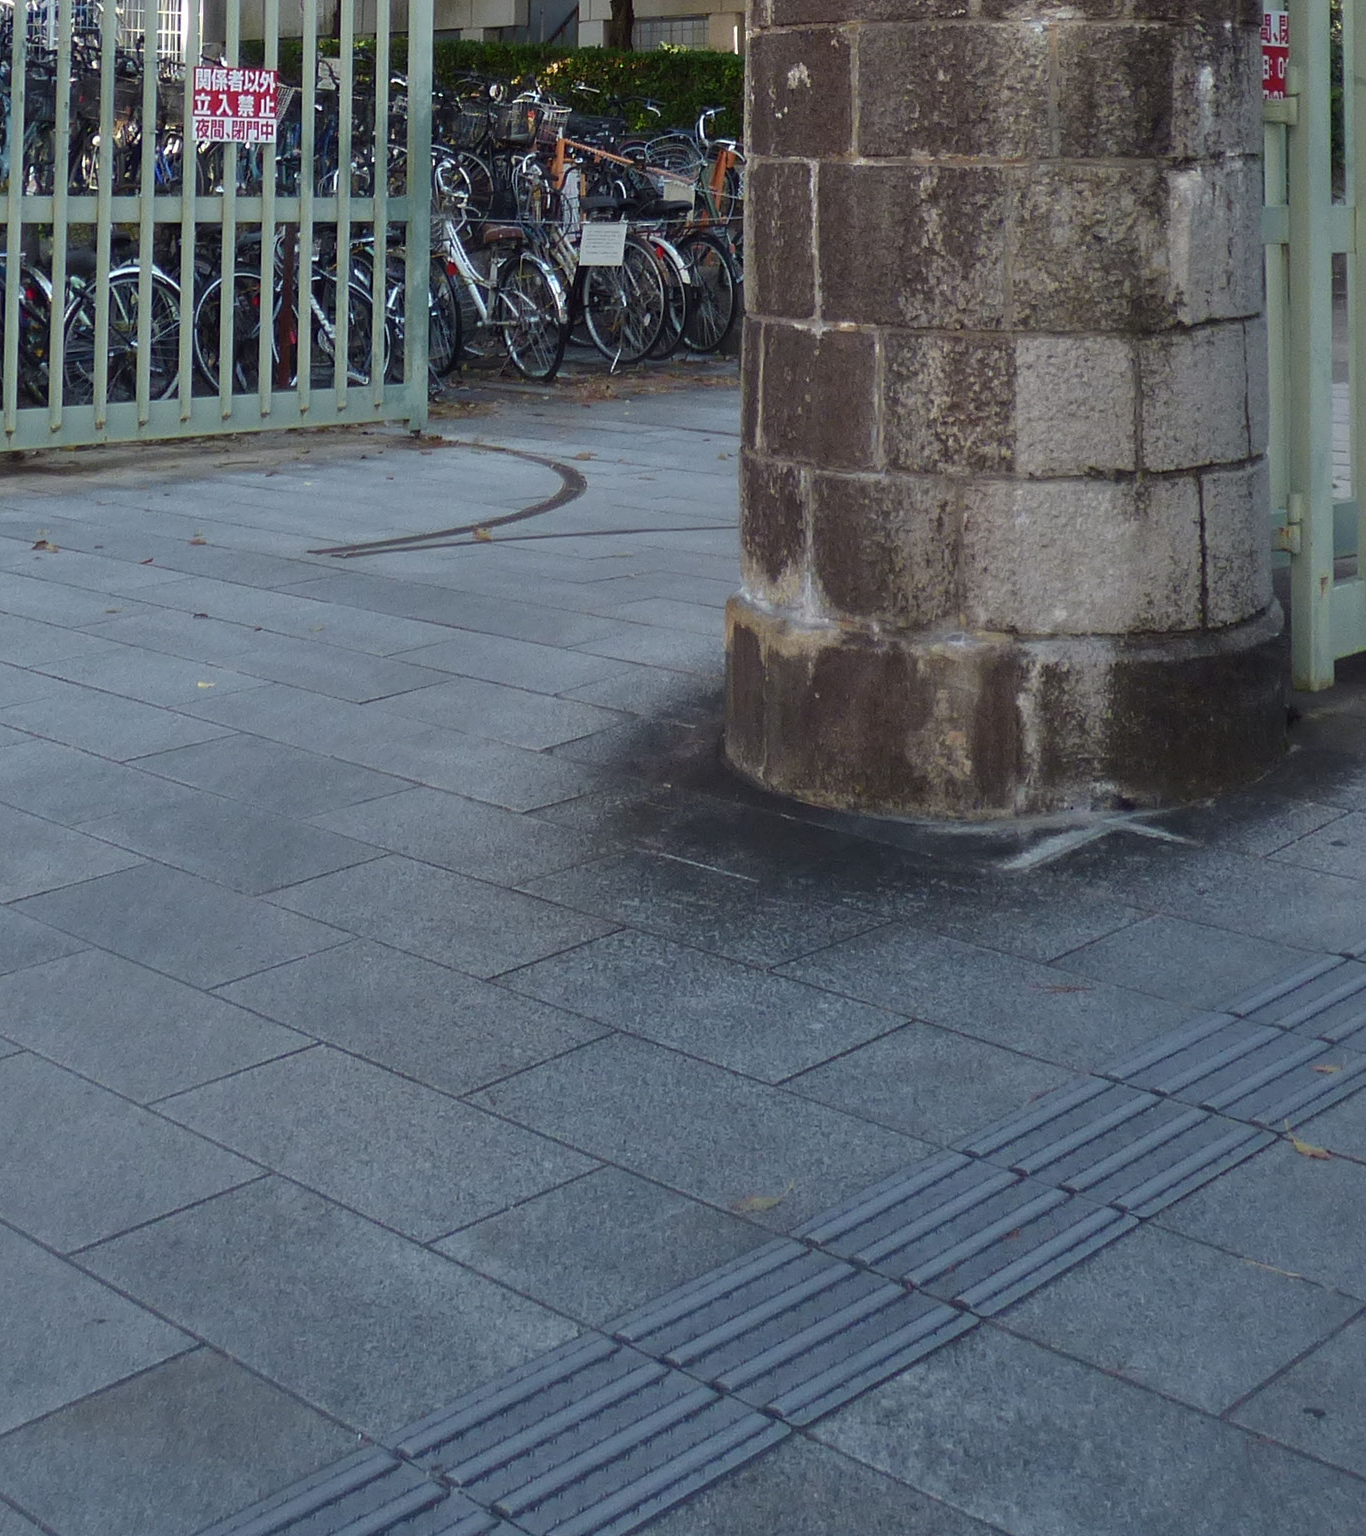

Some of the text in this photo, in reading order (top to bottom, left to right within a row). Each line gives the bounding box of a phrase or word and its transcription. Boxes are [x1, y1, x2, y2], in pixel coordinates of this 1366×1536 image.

[195, 68, 275, 94] 関係者以外
[194, 93, 275, 117] 立入禁止
[196, 119, 274, 141] 夜間、閉門中
